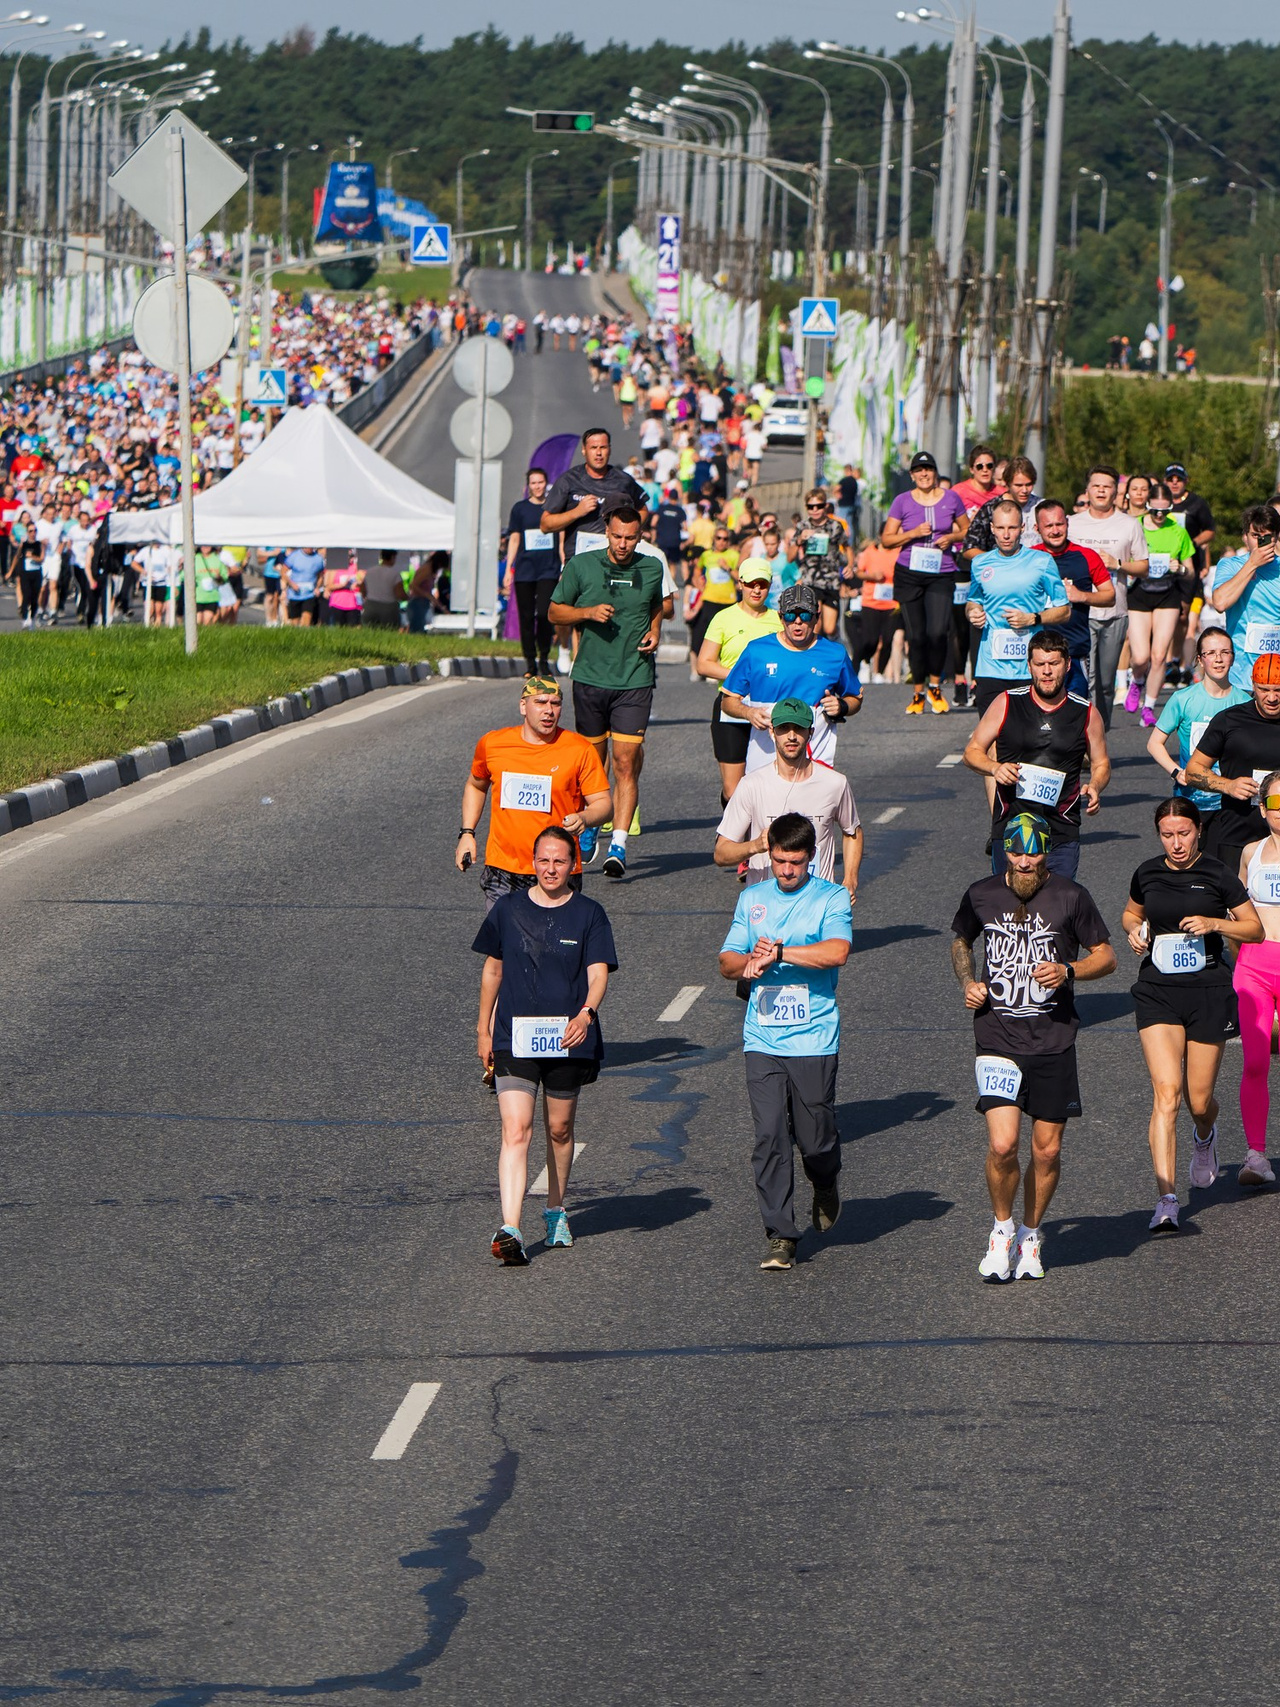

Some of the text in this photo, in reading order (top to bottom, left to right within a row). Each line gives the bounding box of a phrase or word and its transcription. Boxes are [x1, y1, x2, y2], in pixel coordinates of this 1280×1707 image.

[1003, 643, 1027, 656] 4358
[1259, 639, 1280, 652] 2583
[517, 790, 546, 808] 2231
[1002, 912, 1032, 922] WD
[1002, 922, 1034, 932] TRAIL
[1174, 943, 1194, 951] ЕЛЕНА
[1173, 951, 1197, 968] 865
[773, 1003, 806, 1020] 2216
[534, 1027, 559, 1035] ЕВГЕНИЯ
[984, 1066, 1019, 1077] КОНСТАНТИН
[985, 1075, 1016, 1093] 1345
